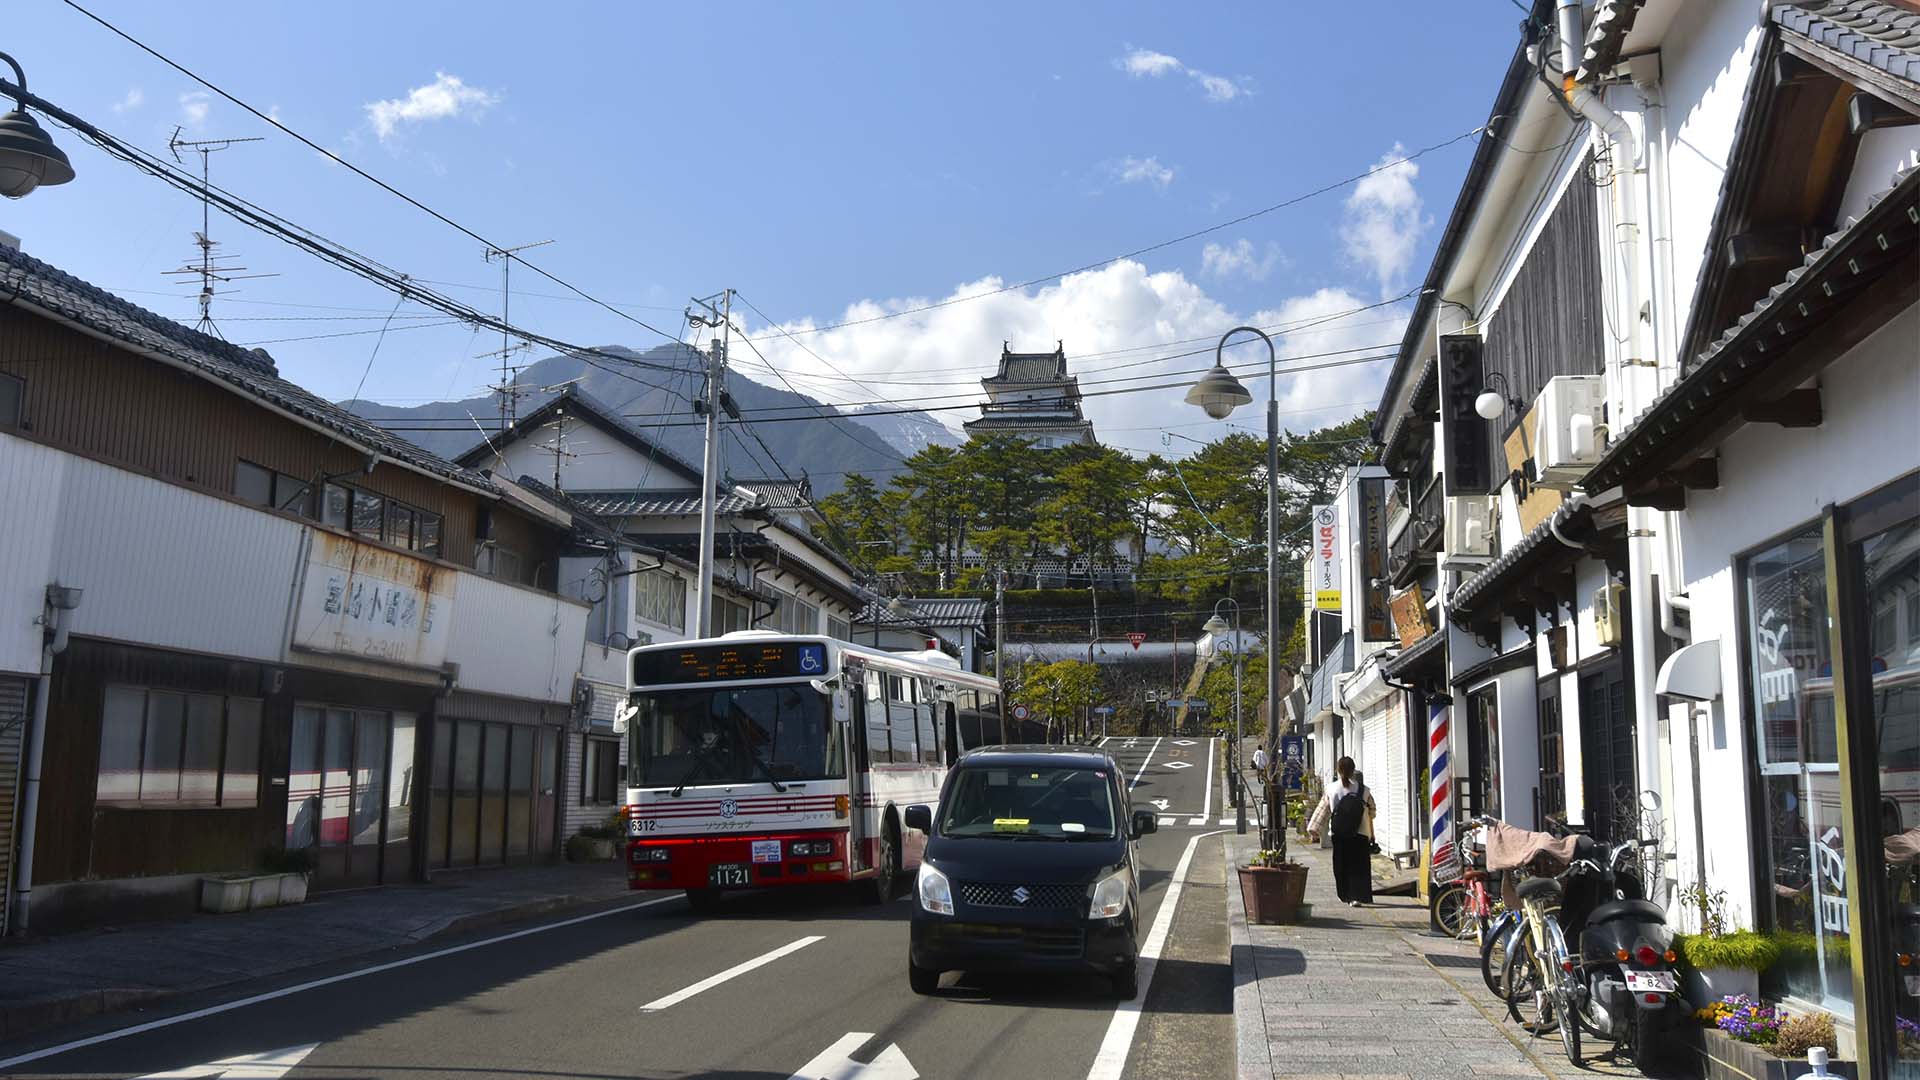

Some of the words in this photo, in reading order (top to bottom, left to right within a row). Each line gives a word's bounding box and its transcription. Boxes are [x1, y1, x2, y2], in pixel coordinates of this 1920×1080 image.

[1319, 525, 1336, 560] ゼブラ
[1323, 560, 1332, 589] ボールペン
[631, 819, 655, 832] 6312
